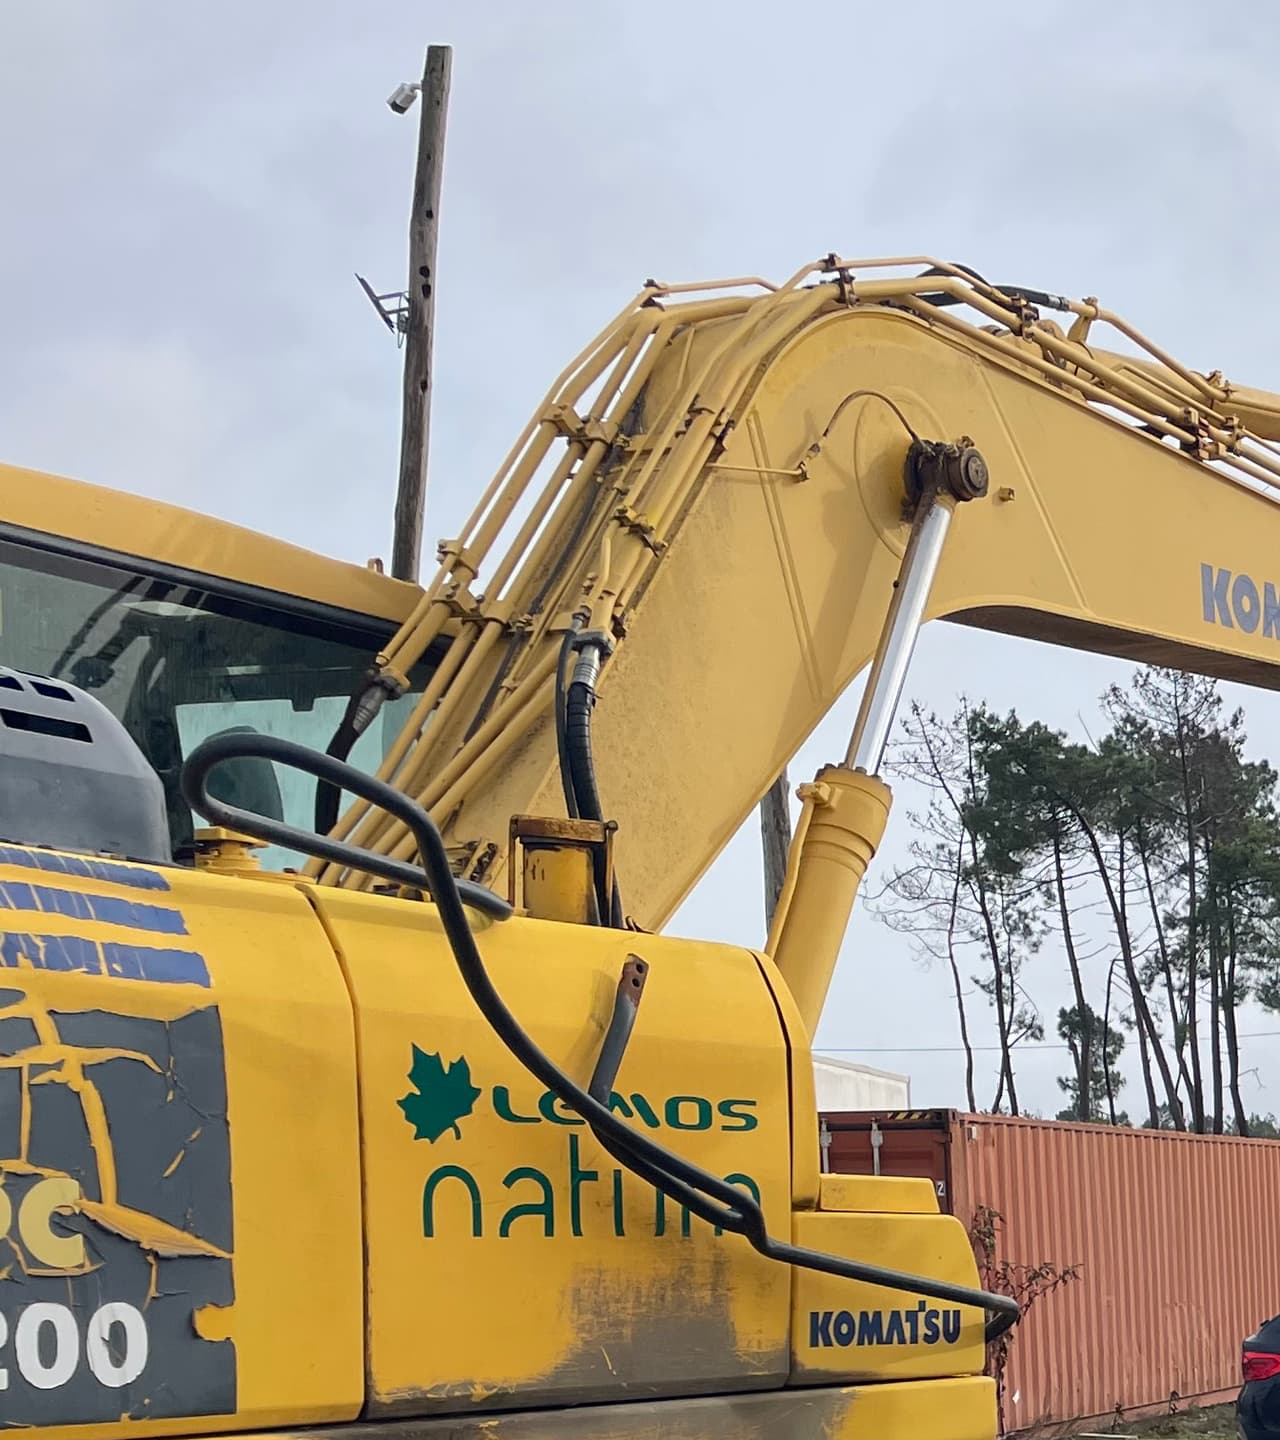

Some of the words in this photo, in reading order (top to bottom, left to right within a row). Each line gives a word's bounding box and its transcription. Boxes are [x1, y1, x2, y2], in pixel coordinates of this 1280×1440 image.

[0, 1177, 84, 1269] C
[0, 1301, 148, 1390] 00
[809, 1300, 961, 1347] KOMATSU
